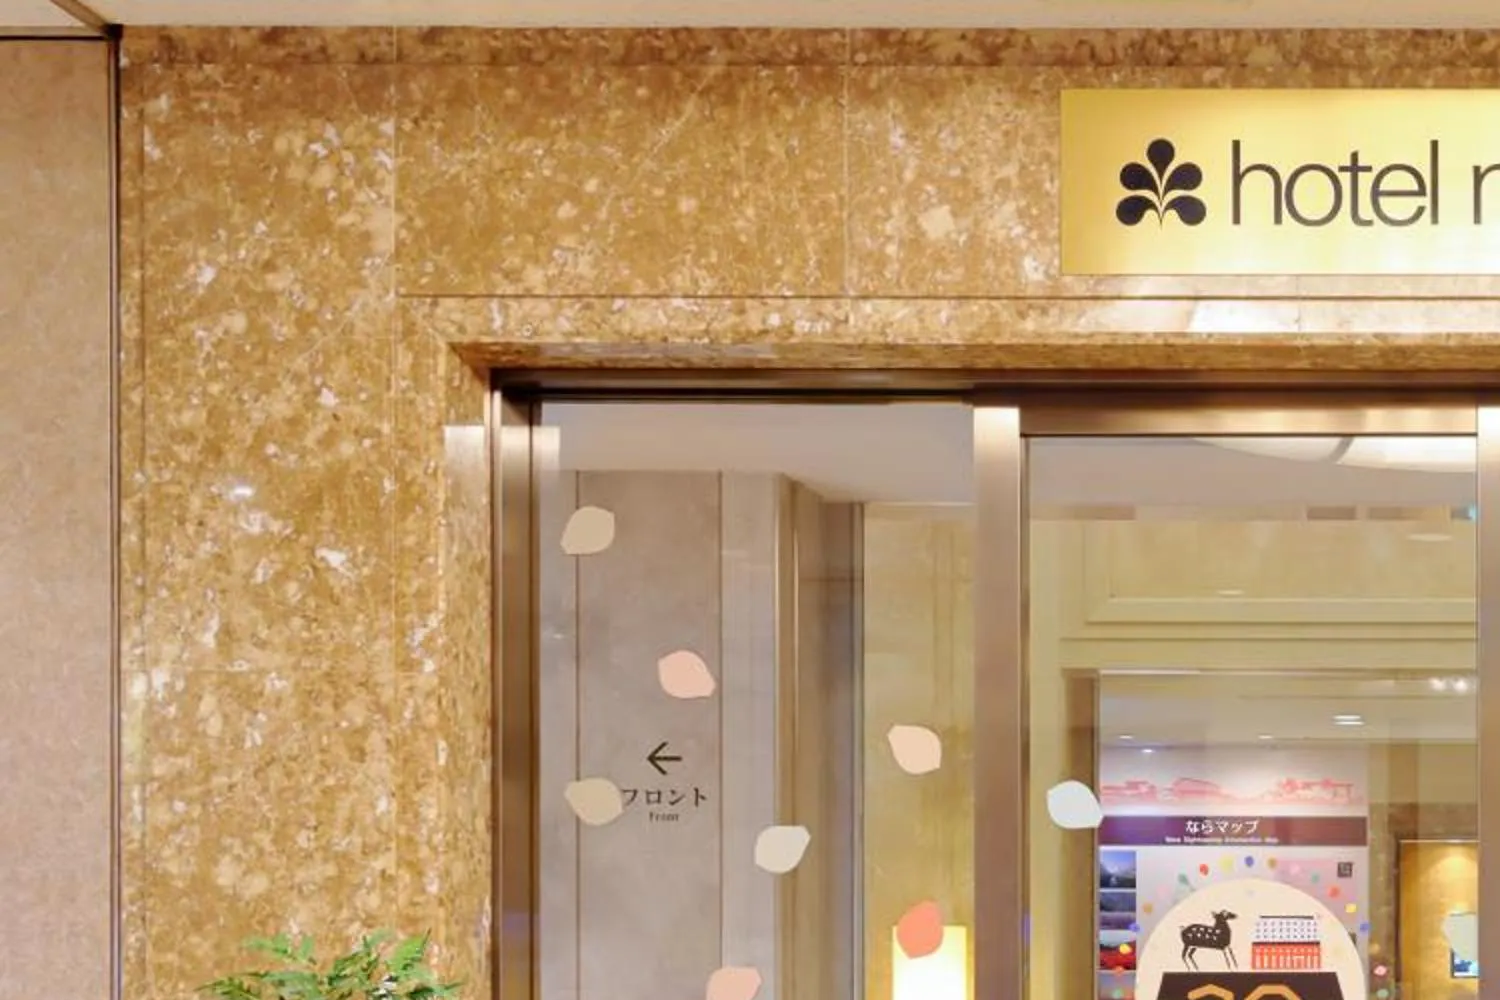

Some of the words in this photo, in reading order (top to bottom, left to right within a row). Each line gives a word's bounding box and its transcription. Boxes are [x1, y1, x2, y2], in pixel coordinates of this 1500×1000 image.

[1233, 140, 1438, 226] hotel
[620, 786, 707, 808] フロント
[1185, 819, 1260, 835] ならマップ
